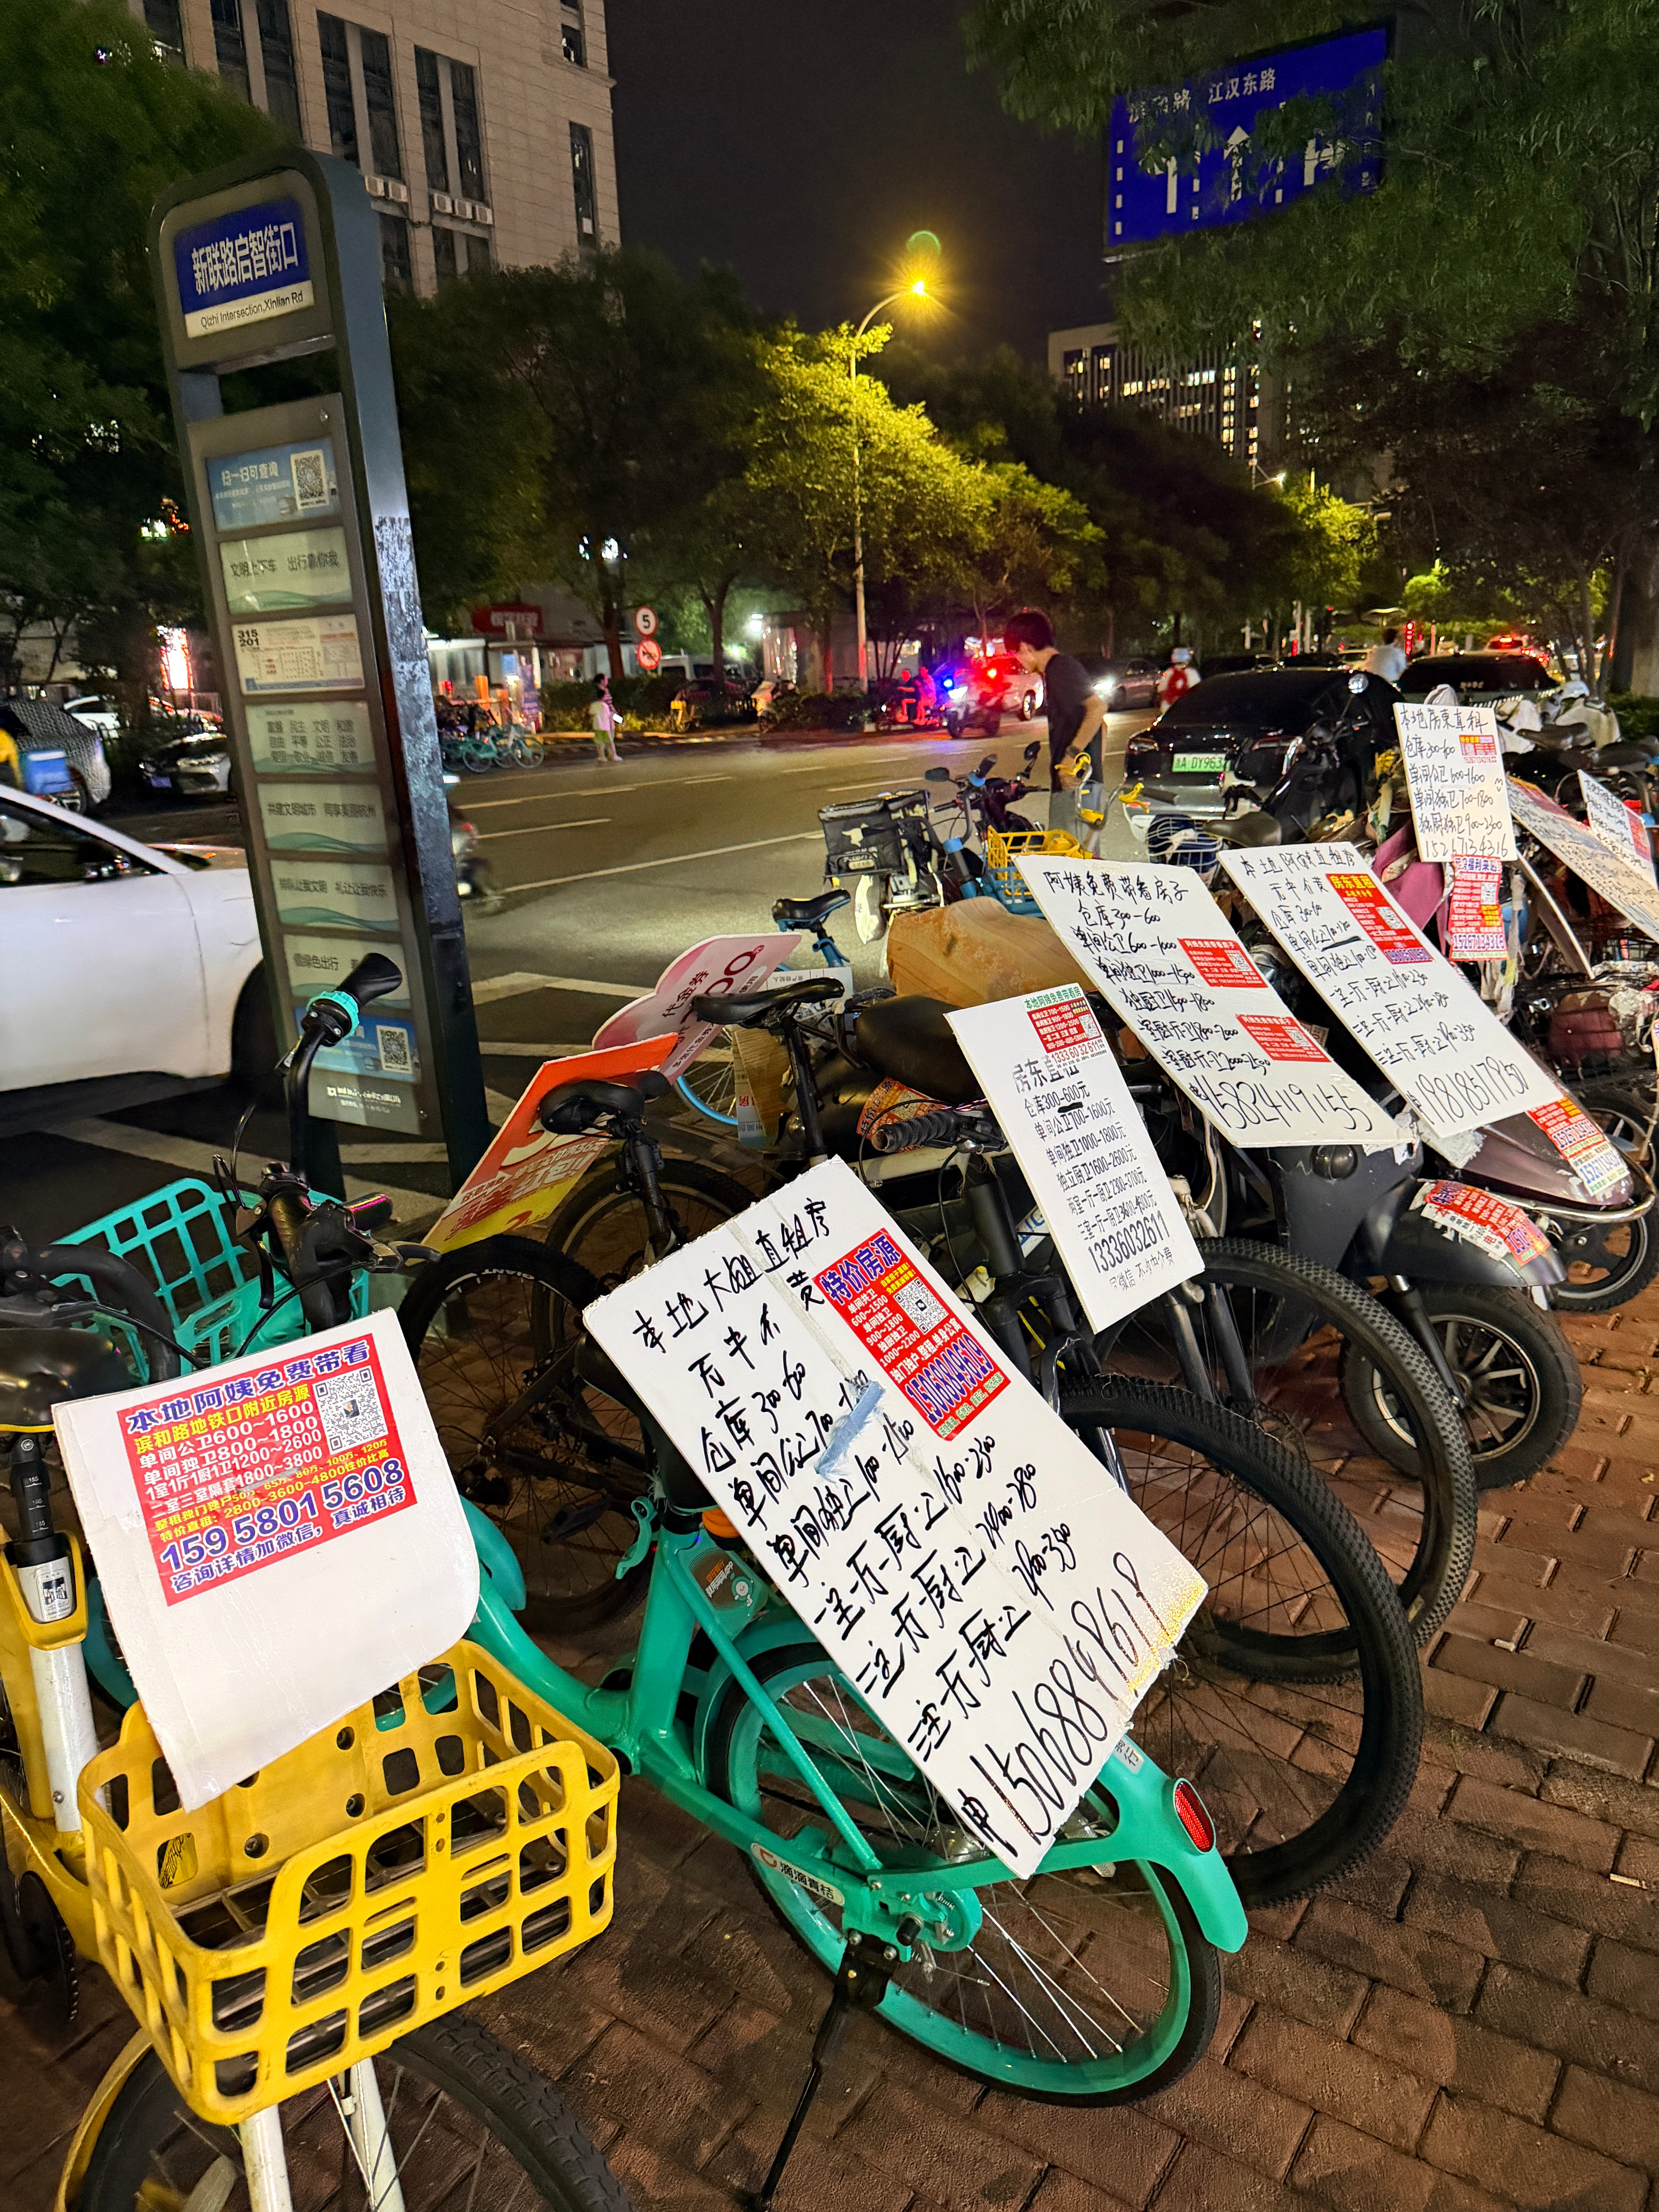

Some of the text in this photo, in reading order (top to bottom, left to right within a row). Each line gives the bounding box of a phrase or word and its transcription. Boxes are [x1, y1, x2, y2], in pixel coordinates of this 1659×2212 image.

[1209, 68, 1276, 104] 江汉东路
[191, 222, 298, 295] 新联路启智街口
[201, 312, 219, 328] Qizhi
[291, 290, 304, 304] Rd
[237, 629, 258, 639] 315
[239, 638, 259, 647] 201
[642, 615, 651, 629] 5
[1191, 757, 1223, 769] DY963
[1043, 871, 1189, 905] 阿姨免费带看房子
[1269, 877, 1328, 902] 无中介费
[1329, 874, 1376, 890] 房东直租
[662, 970, 709, 1018] 代金券
[1024, 986, 1082, 1010] 本地阿姨免费带看房
[1052, 1049, 1070, 1064] 1333
[1069, 1046, 1080, 1059] 60
[1078, 1043, 1089, 1055] 32
[1024, 1081, 1090, 1118] 仓库300-600元
[1034, 1097, 1116, 1142] 单间公卫700-1600元
[1046, 1121, 1127, 1168] 单间独卫1000-1800元
[1056, 1143, 1137, 1192] 独立厨卫1600-2600元
[1088, 1209, 1170, 1274] 13336032611
[632, 1197, 830, 1354] 本地大姐直租房
[819, 1235, 902, 1305] 特价房源
[847, 1288, 879, 1314] 单间共卫
[862, 1307, 893, 1333] 单间独卫
[688, 1269, 824, 1398] 无中介费
[877, 1326, 908, 1353] 独厨独卫
[126, 1340, 370, 1434] 本地阿姨免费带看
[905, 1333, 994, 1425] 15068849619
[134, 1384, 311, 1455] 滨和路地铁口附近房源
[140, 1401, 314, 1469] 单间公卫600~1600
[144, 1416, 318, 1485] 单间独卫800~1800
[160, 1457, 405, 1573] 159 5801 5608
[330, 1486, 406, 1530] 真诚相待
[780, 1862, 834, 1900] 滴滴青桔
